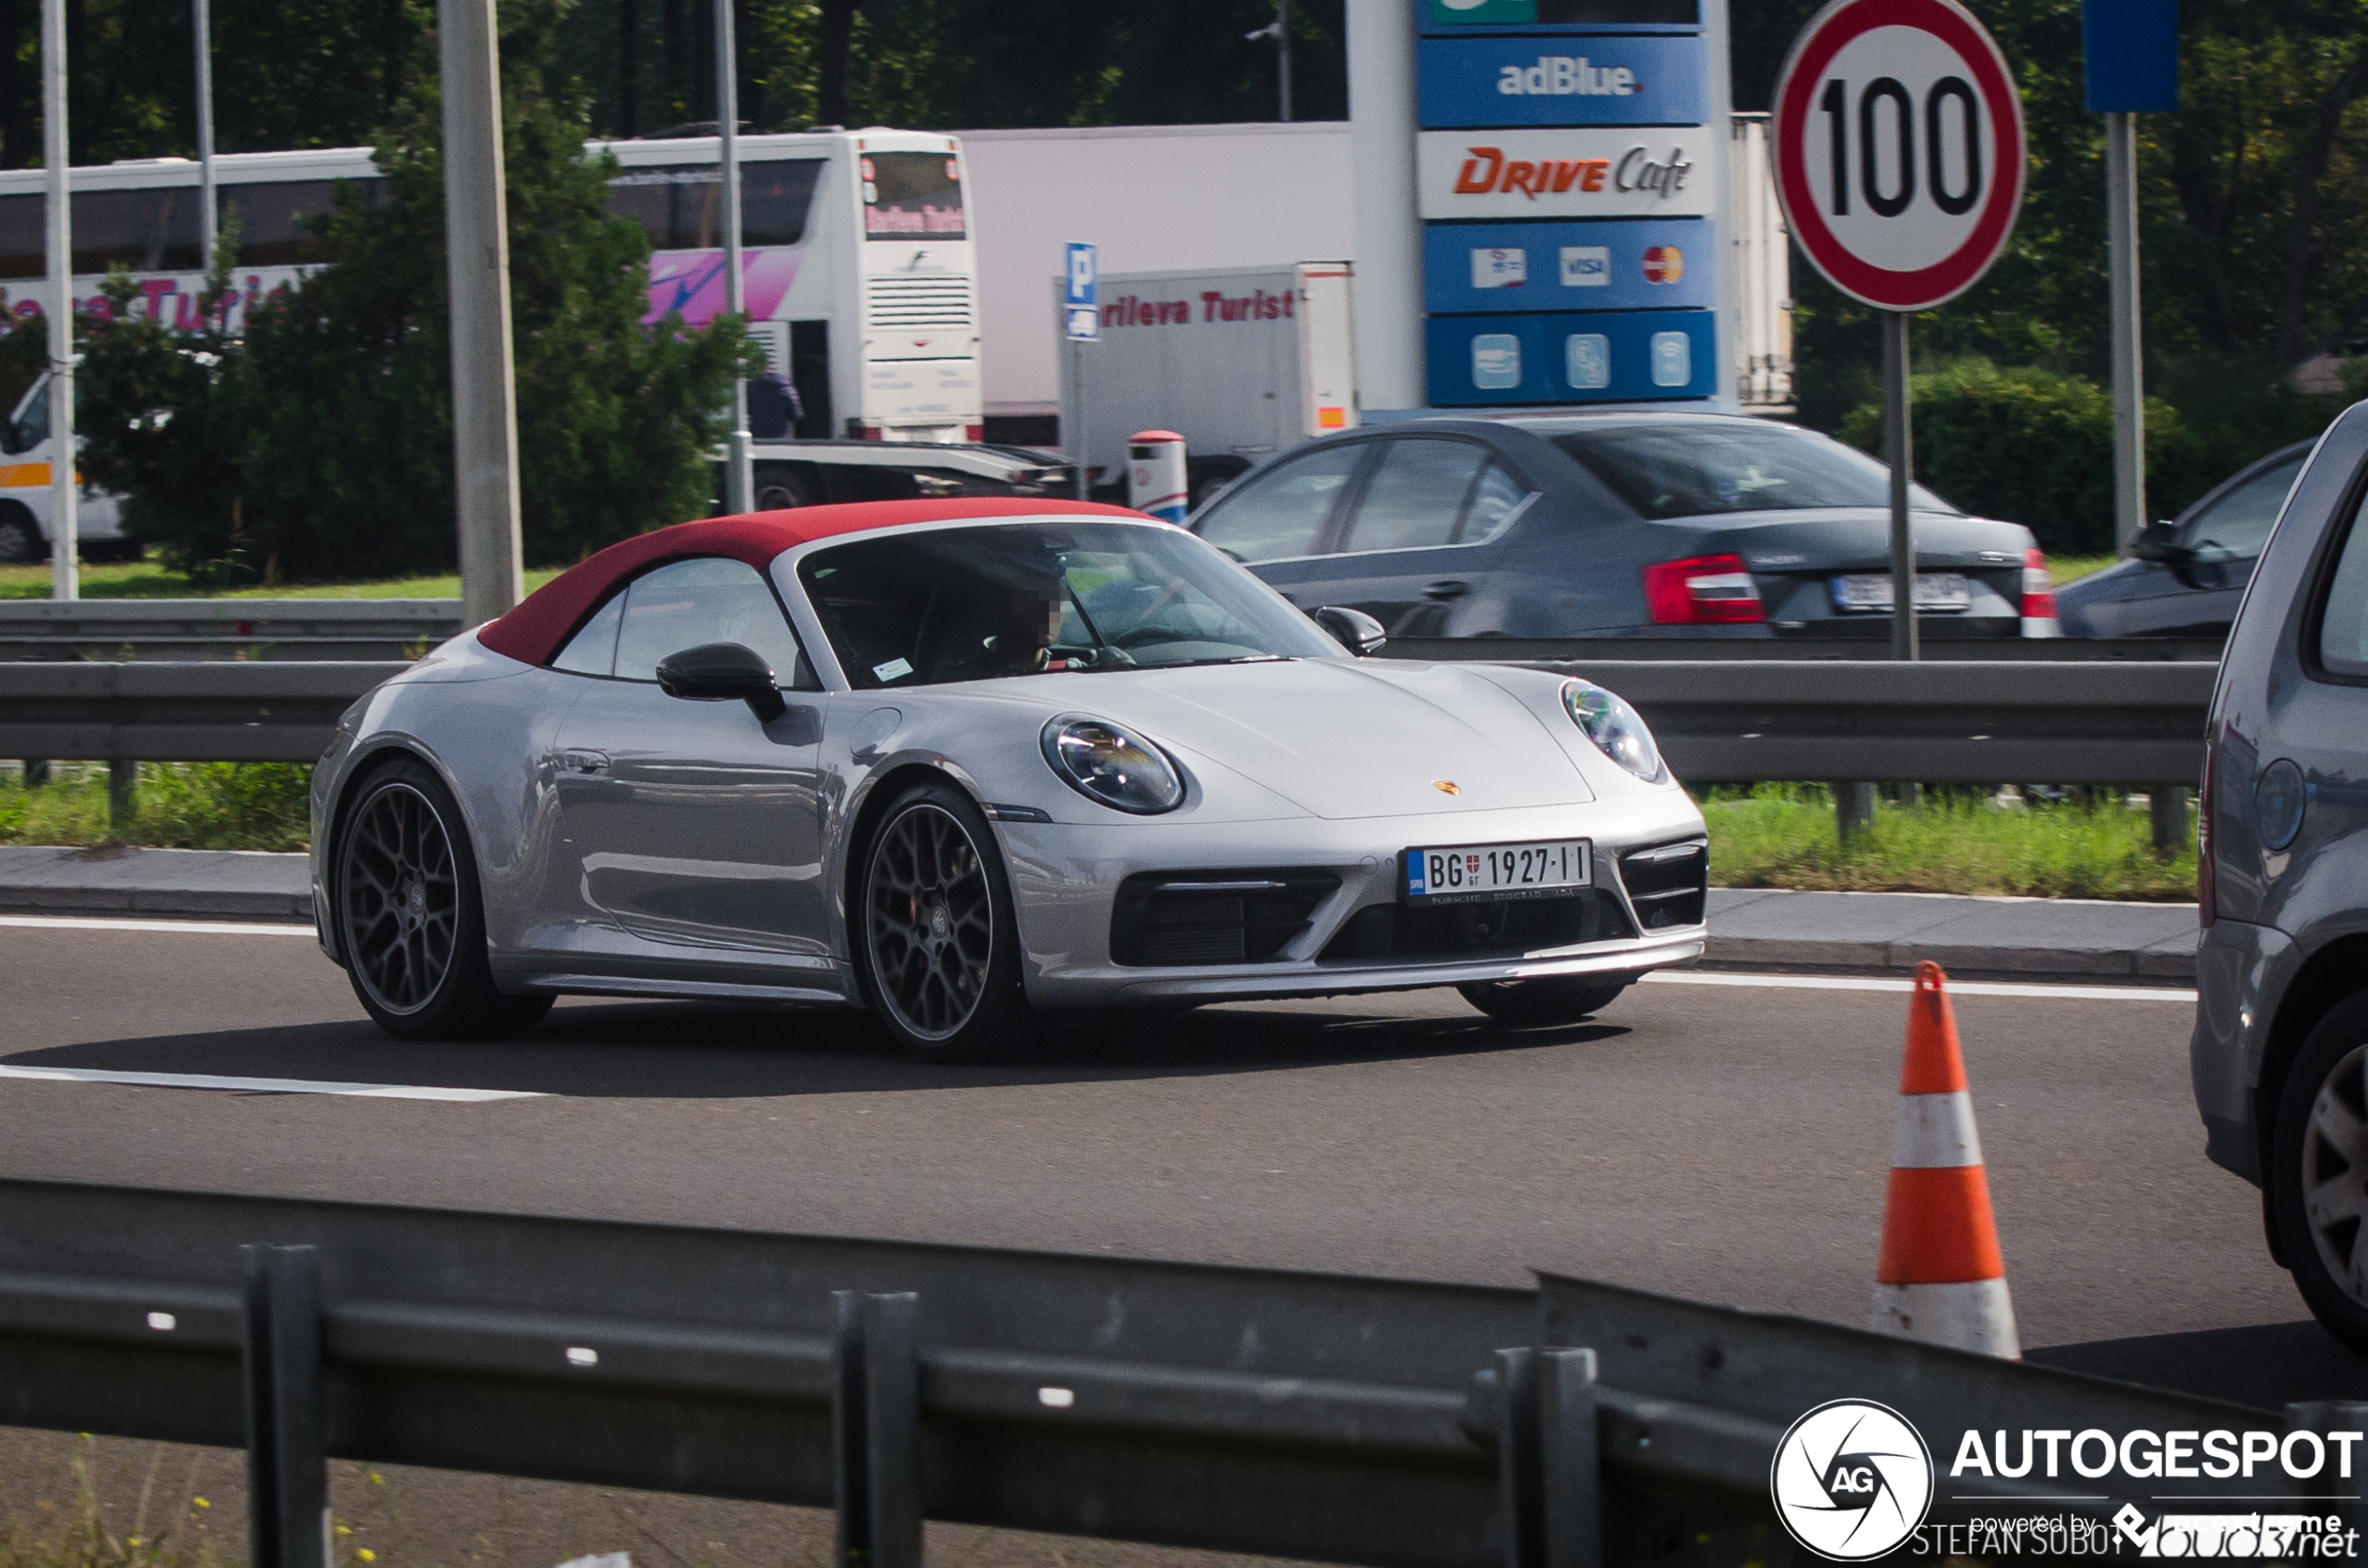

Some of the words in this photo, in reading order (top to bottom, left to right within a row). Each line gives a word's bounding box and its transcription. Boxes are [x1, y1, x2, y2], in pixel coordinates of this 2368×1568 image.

[1820, 76, 1983, 217] 100
[1452, 146, 1611, 200] DRIVE
[1072, 250, 1092, 297] P
[1202, 288, 1295, 323] Turist
[1411, 879, 1424, 889] SRB
[1430, 853, 1463, 888] BG
[1432, 894, 1481, 905] PORSCHE
[1494, 890, 1542, 901] BEOGRAD
[1554, 888, 1575, 898] ADA
